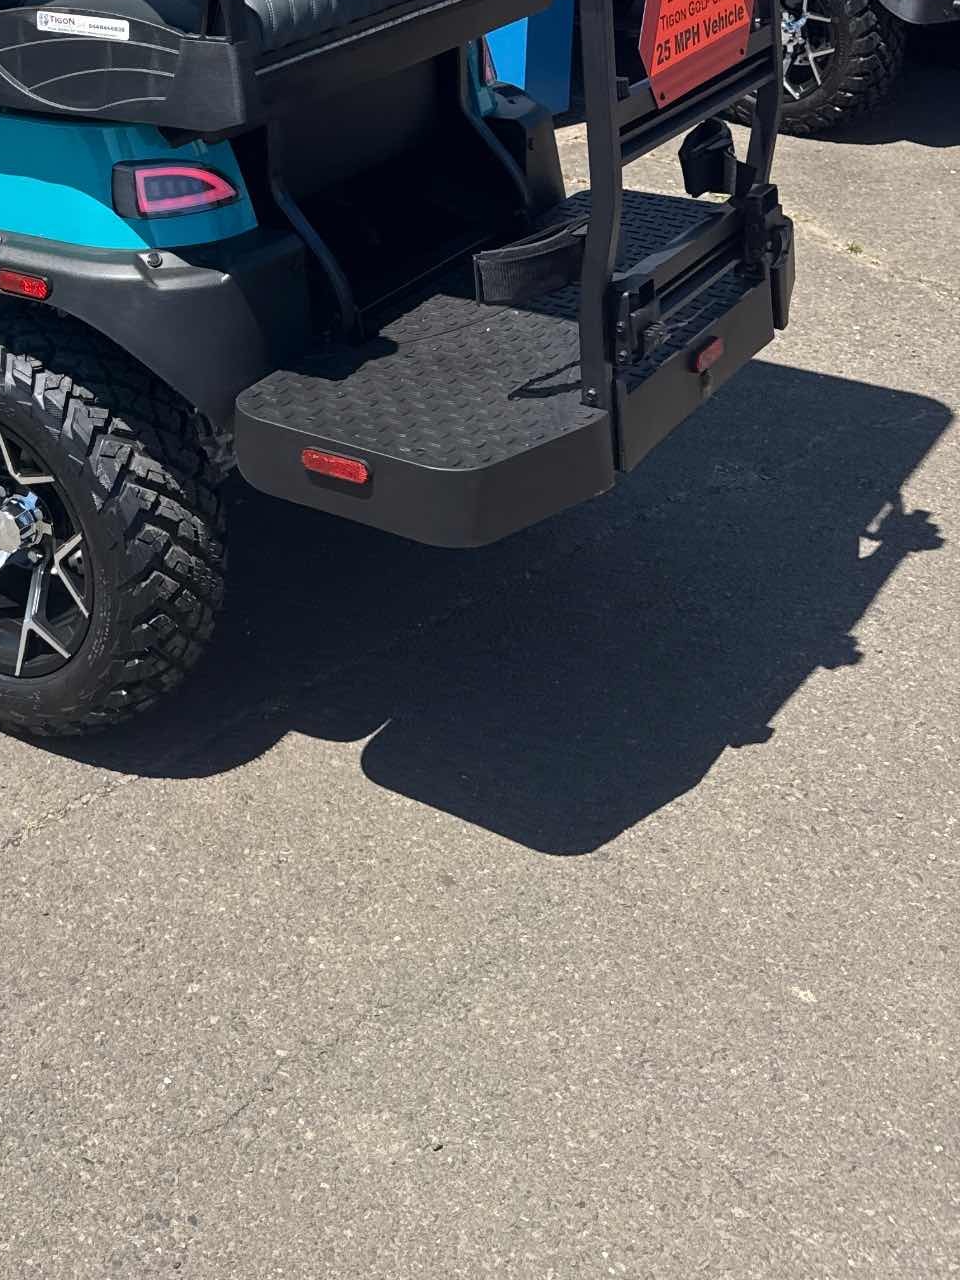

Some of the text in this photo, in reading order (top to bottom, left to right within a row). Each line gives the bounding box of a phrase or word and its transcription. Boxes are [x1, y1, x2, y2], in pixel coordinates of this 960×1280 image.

[49, 15, 76, 26] TIGON
[660, 8, 687, 31] TIGON
[656, 3, 744, 65] 25 MPH Vehicle
